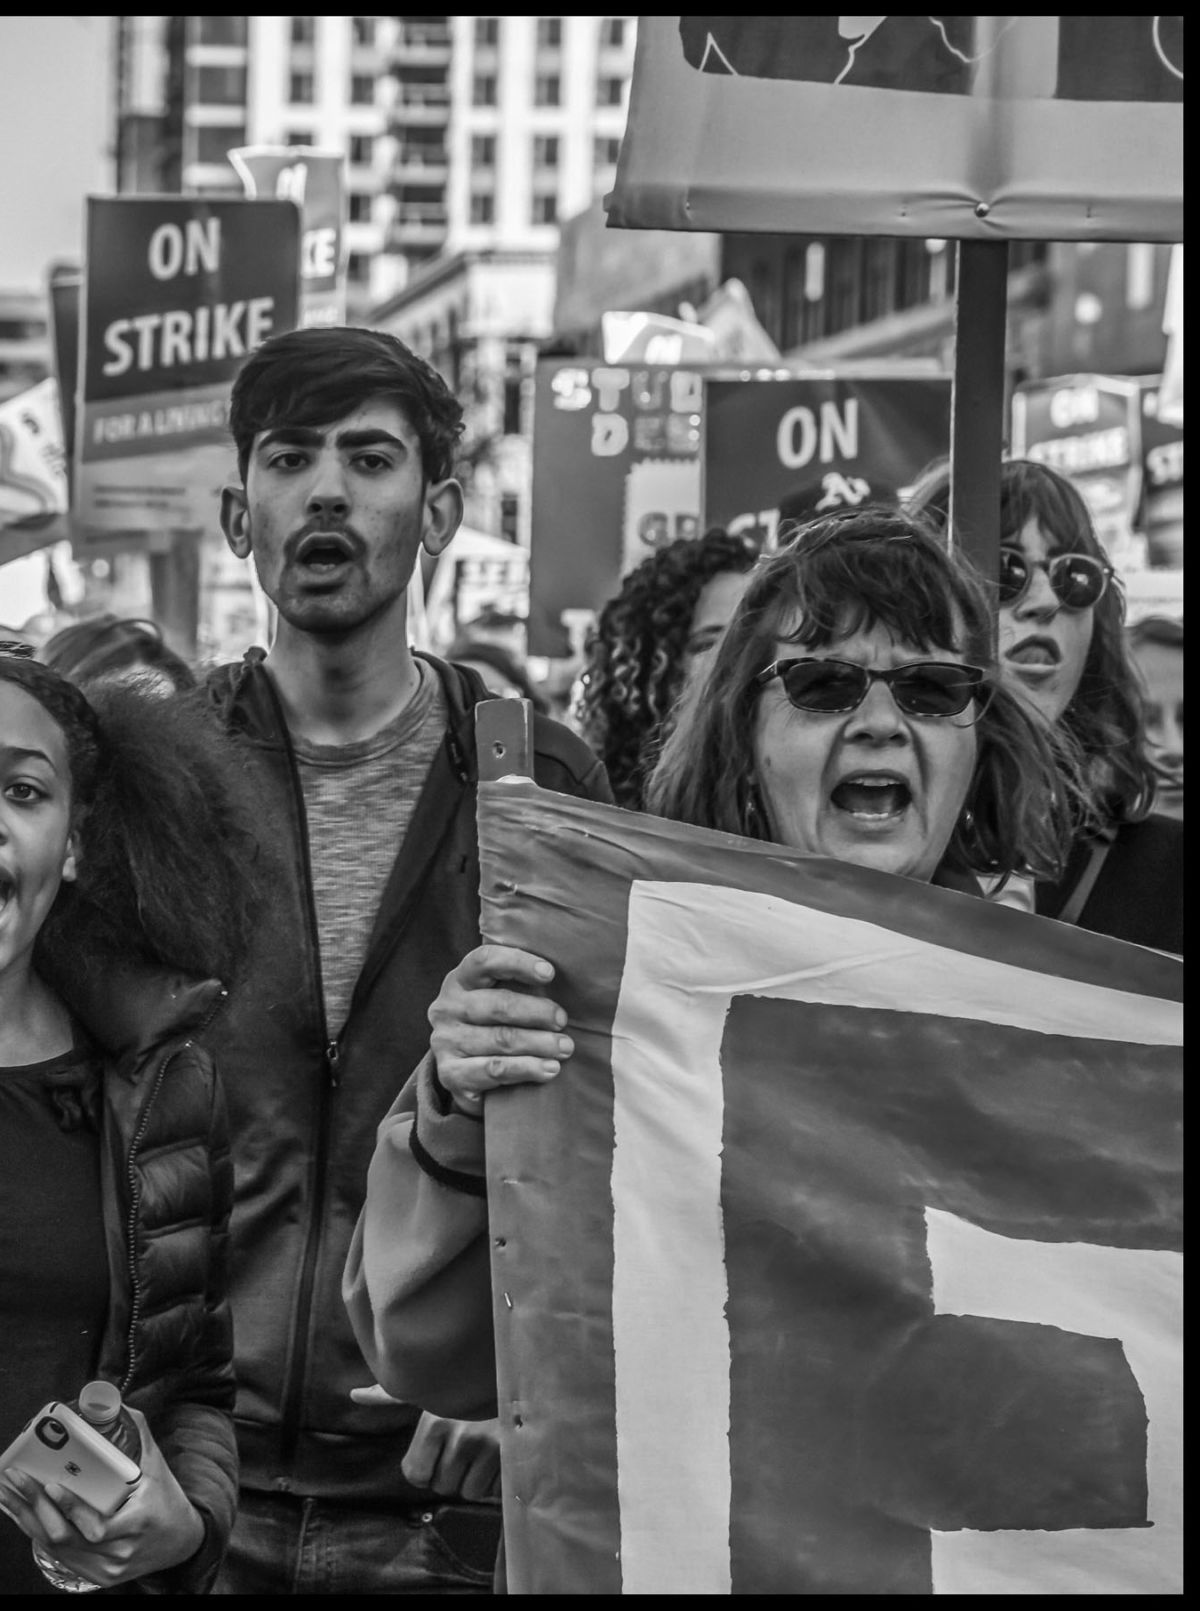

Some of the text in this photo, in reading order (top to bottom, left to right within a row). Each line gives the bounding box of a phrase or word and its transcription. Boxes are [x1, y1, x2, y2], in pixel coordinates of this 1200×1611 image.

[148, 216, 221, 281] ON
[102, 296, 275, 377] STRIKE
[776, 397, 859, 470] ON
